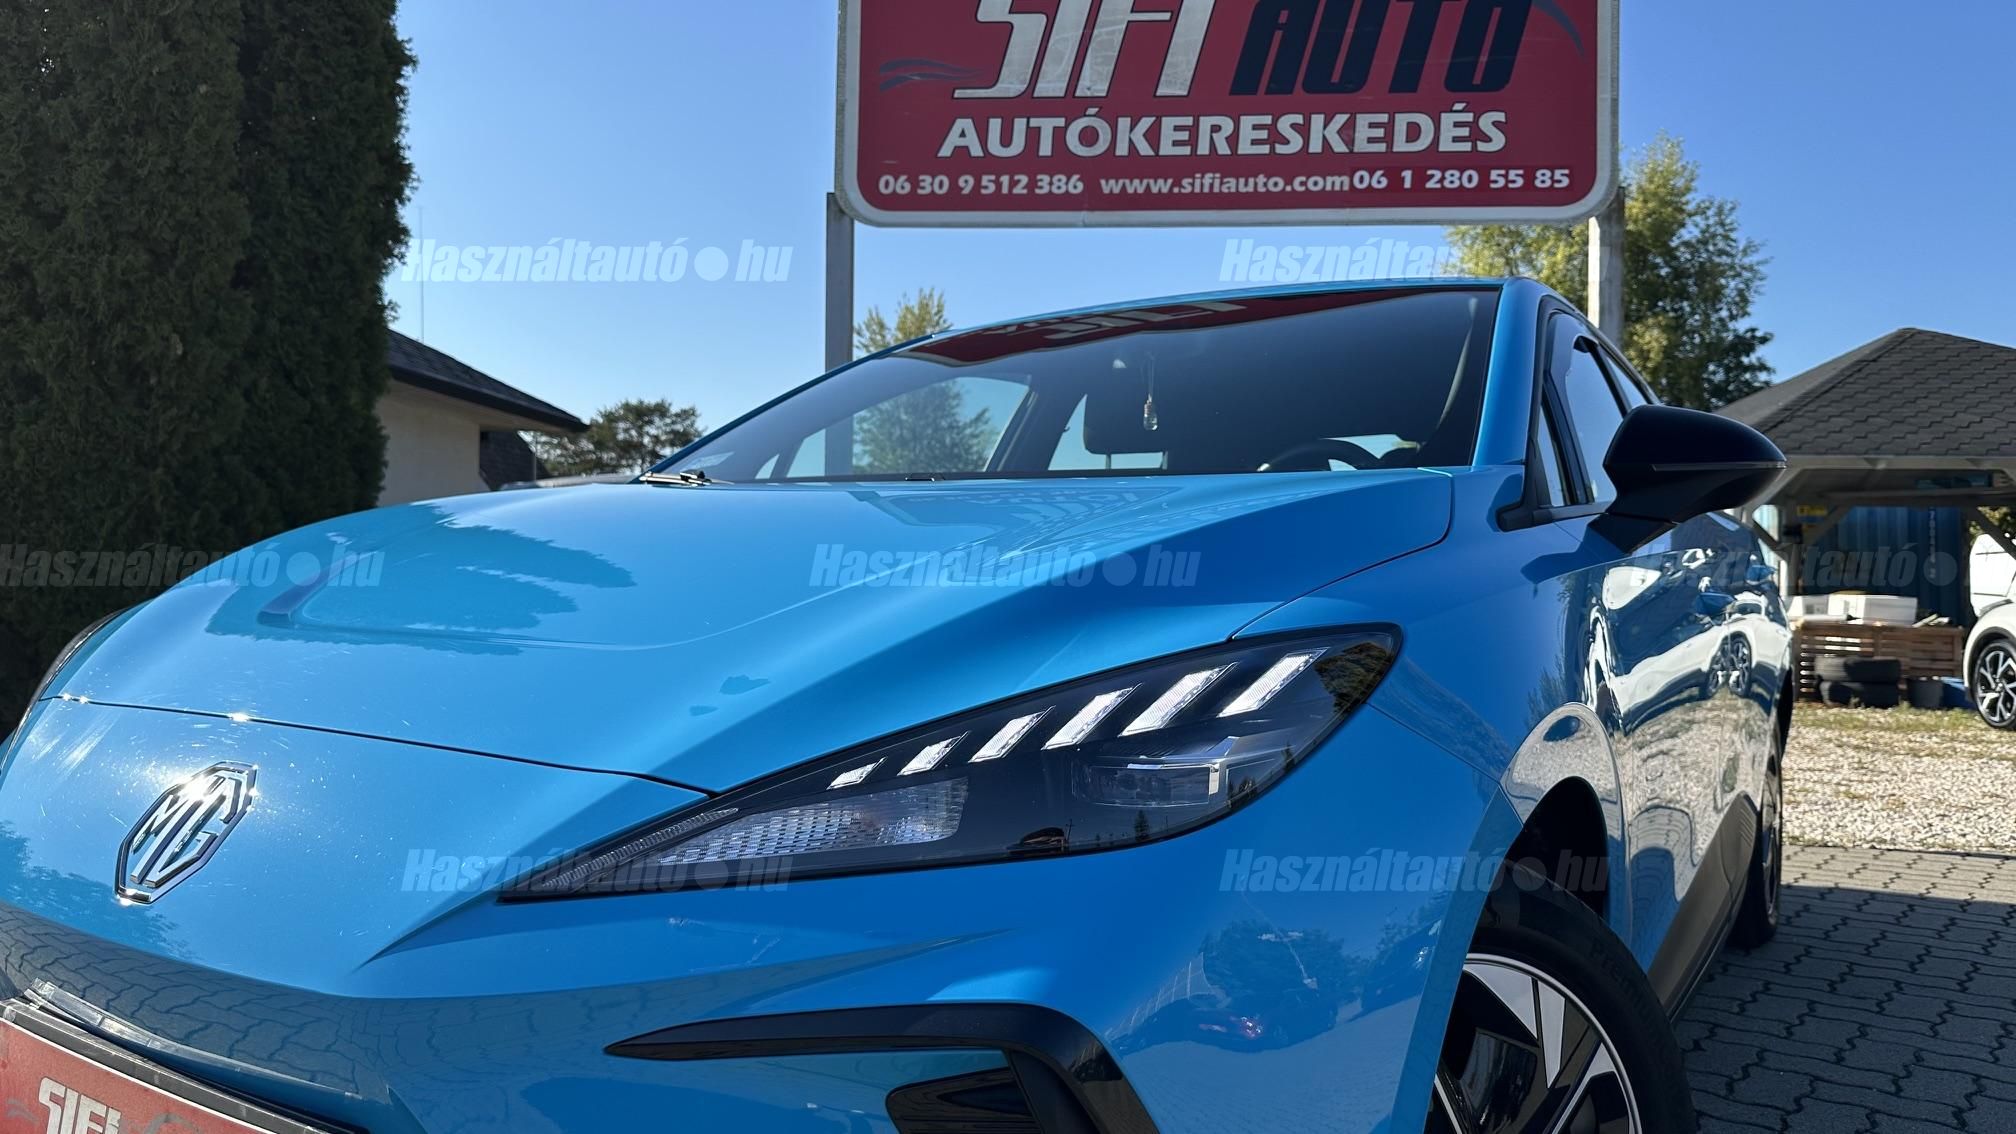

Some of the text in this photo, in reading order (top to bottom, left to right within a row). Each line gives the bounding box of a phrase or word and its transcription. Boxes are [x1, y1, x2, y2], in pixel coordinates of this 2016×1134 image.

[954, 0, 1532, 98] SIFI AUTO
[937, 102, 1507, 158] AUTÓKERESKEDÉS
[878, 168, 1571, 195] 06 30 9 512 386 www.sifiauto.com 06 1 280 55 85
[130, 772, 244, 889] MG
